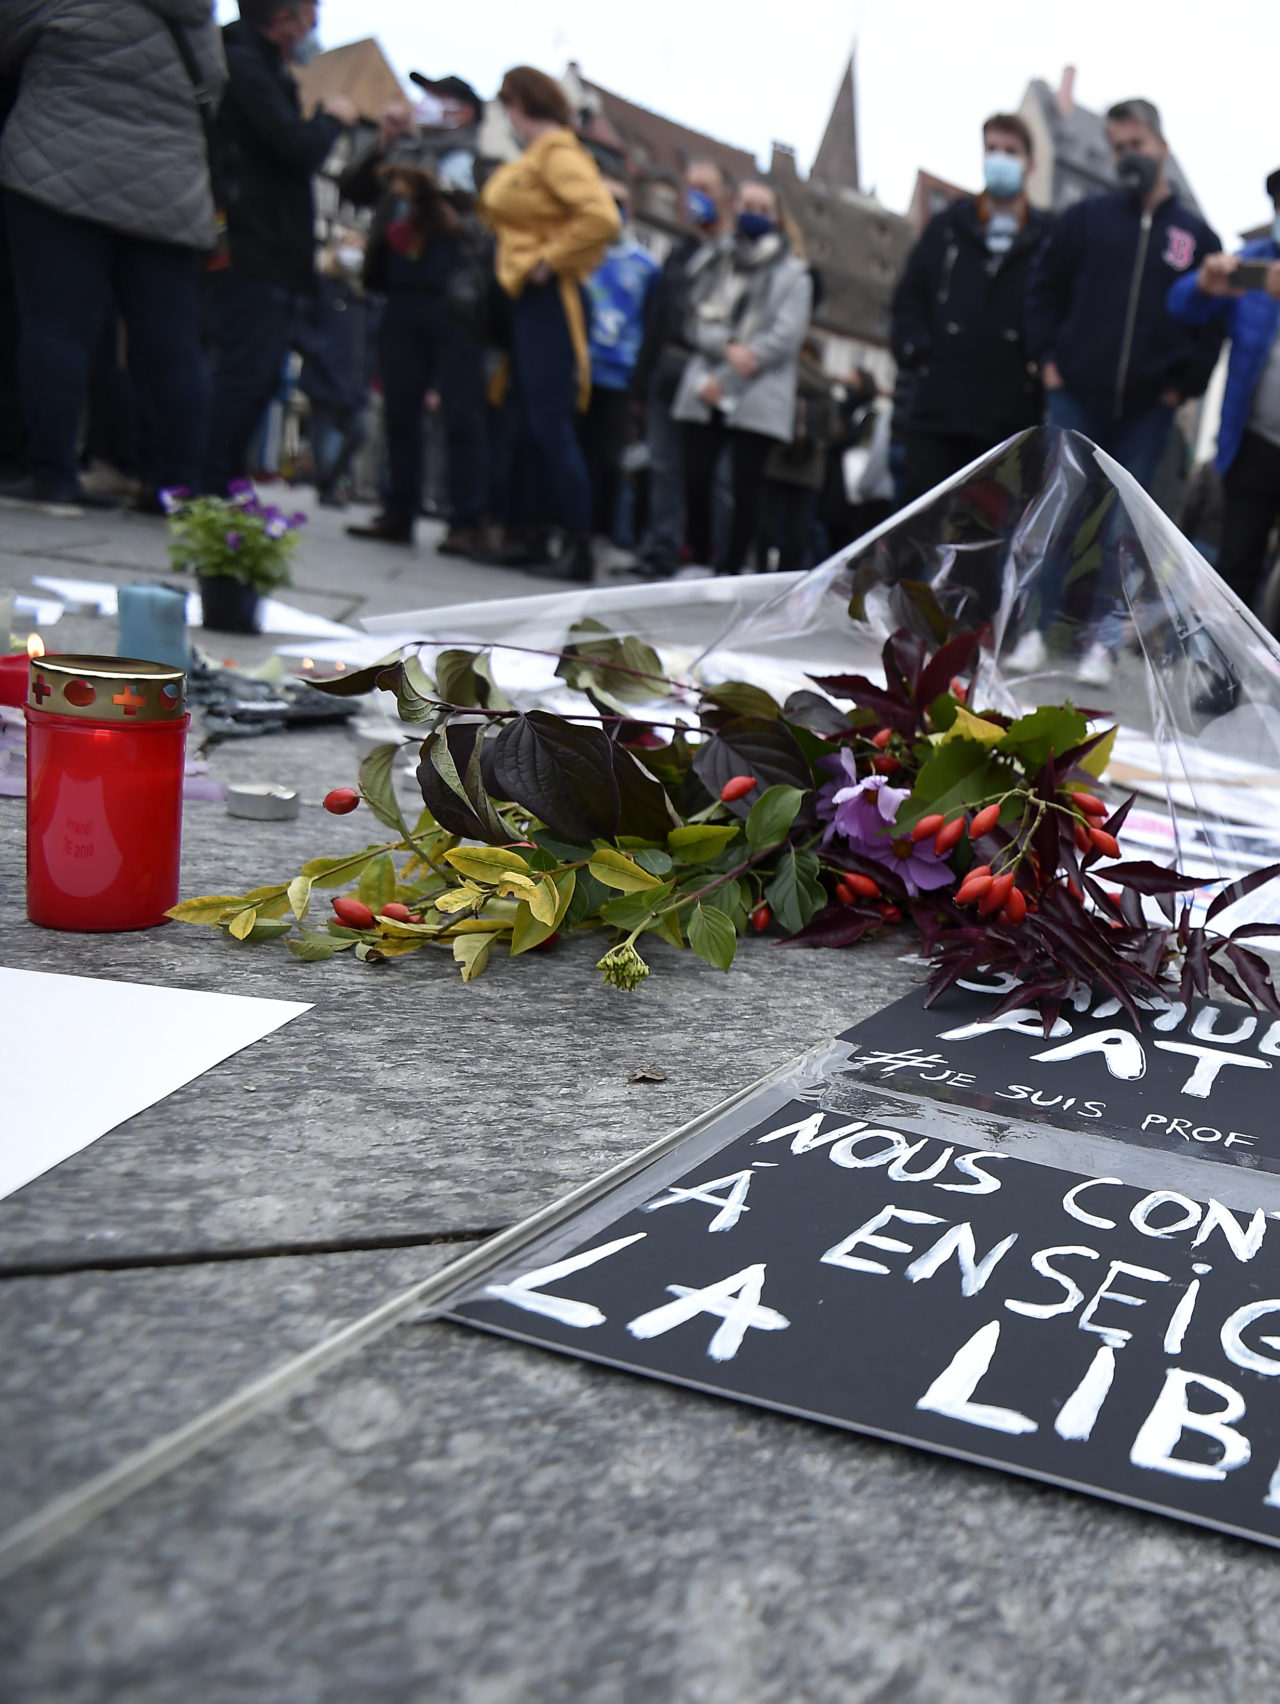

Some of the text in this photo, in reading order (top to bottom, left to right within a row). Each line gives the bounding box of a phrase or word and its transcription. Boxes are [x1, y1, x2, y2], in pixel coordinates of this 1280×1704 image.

[750, 1112, 1009, 1196] NOUS
[995, 1084, 1106, 1117] SUIS
[1141, 1113, 1260, 1148] PROF
[484, 1231, 791, 1362] LA
